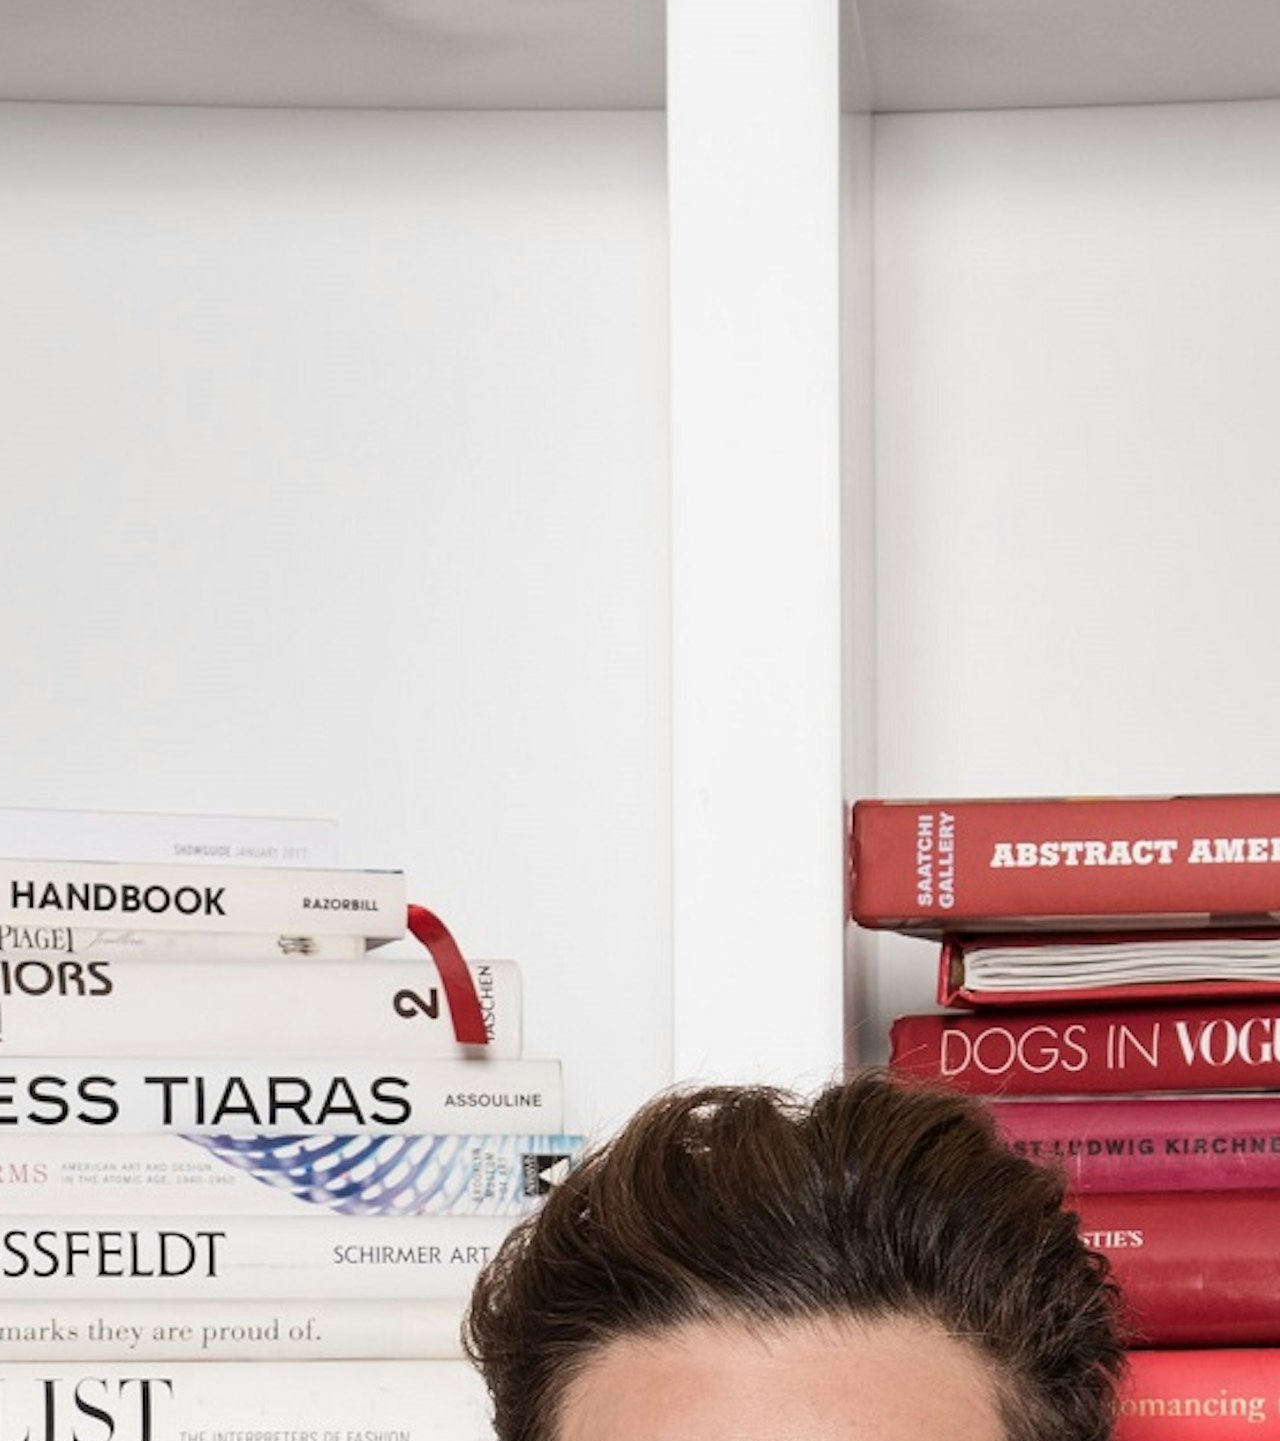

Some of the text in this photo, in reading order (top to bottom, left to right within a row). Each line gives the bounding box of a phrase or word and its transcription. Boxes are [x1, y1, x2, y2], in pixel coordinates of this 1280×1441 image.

[917, 814, 934, 907] SAATCHI
[938, 811, 956, 910] GALLERY
[990, 840, 1178, 869] ABSTRACT
[11, 880, 378, 916] HANDBOOK RAZORBILL
[940, 1024, 1089, 1076] DOGS
[1107, 1023, 1160, 1070] IN
[144, 1076, 412, 1126] TIARAS
[444, 1093, 542, 1108] ASSOULINE
[333, 1246, 441, 1265] SCHIRMER
[450, 1247, 490, 1265] ART
